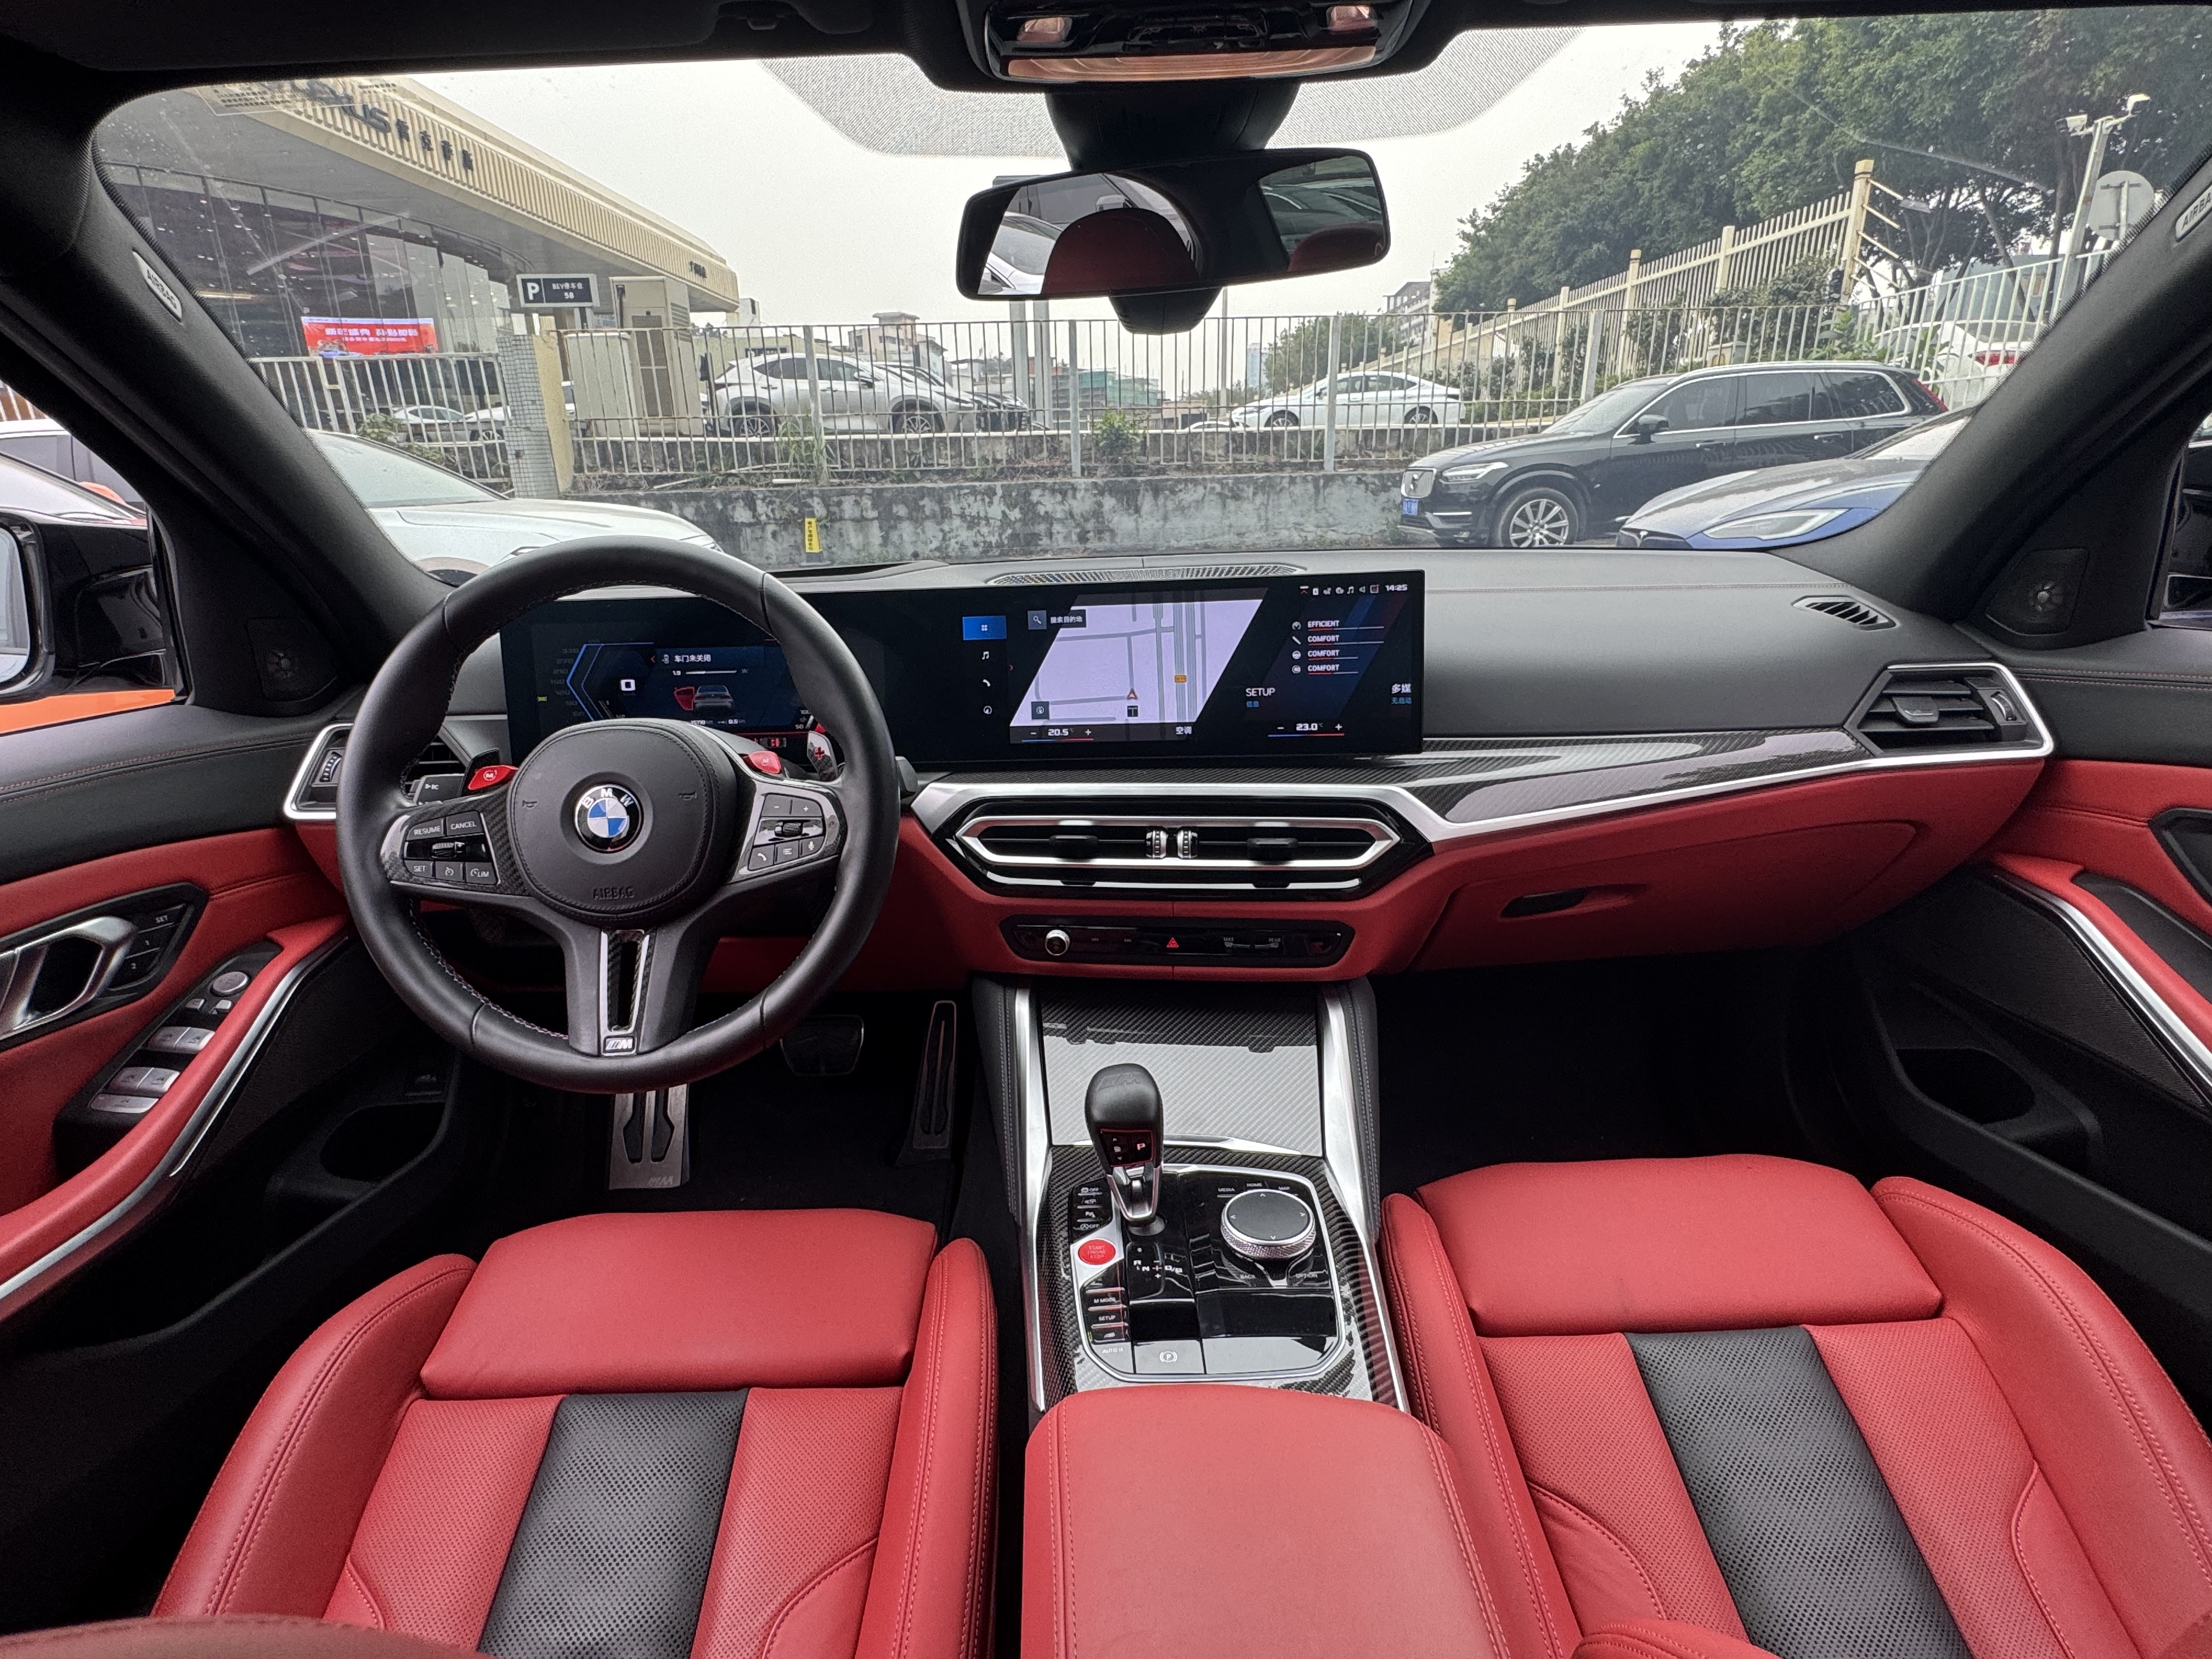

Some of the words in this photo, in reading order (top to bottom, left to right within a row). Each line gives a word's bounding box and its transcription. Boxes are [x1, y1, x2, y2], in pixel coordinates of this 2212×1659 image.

[146, 269, 177, 309] AIRBAG
[527, 282, 539, 301] P
[620, 679, 635, 691] 0
[1246, 687, 1276, 697] SETUP
[1176, 726, 1192, 735] 空调
[582, 788, 634, 809] BMW
[414, 826, 441, 835] RESUME
[450, 821, 477, 830] CANCEL
[593, 887, 634, 900] AIRBAG
